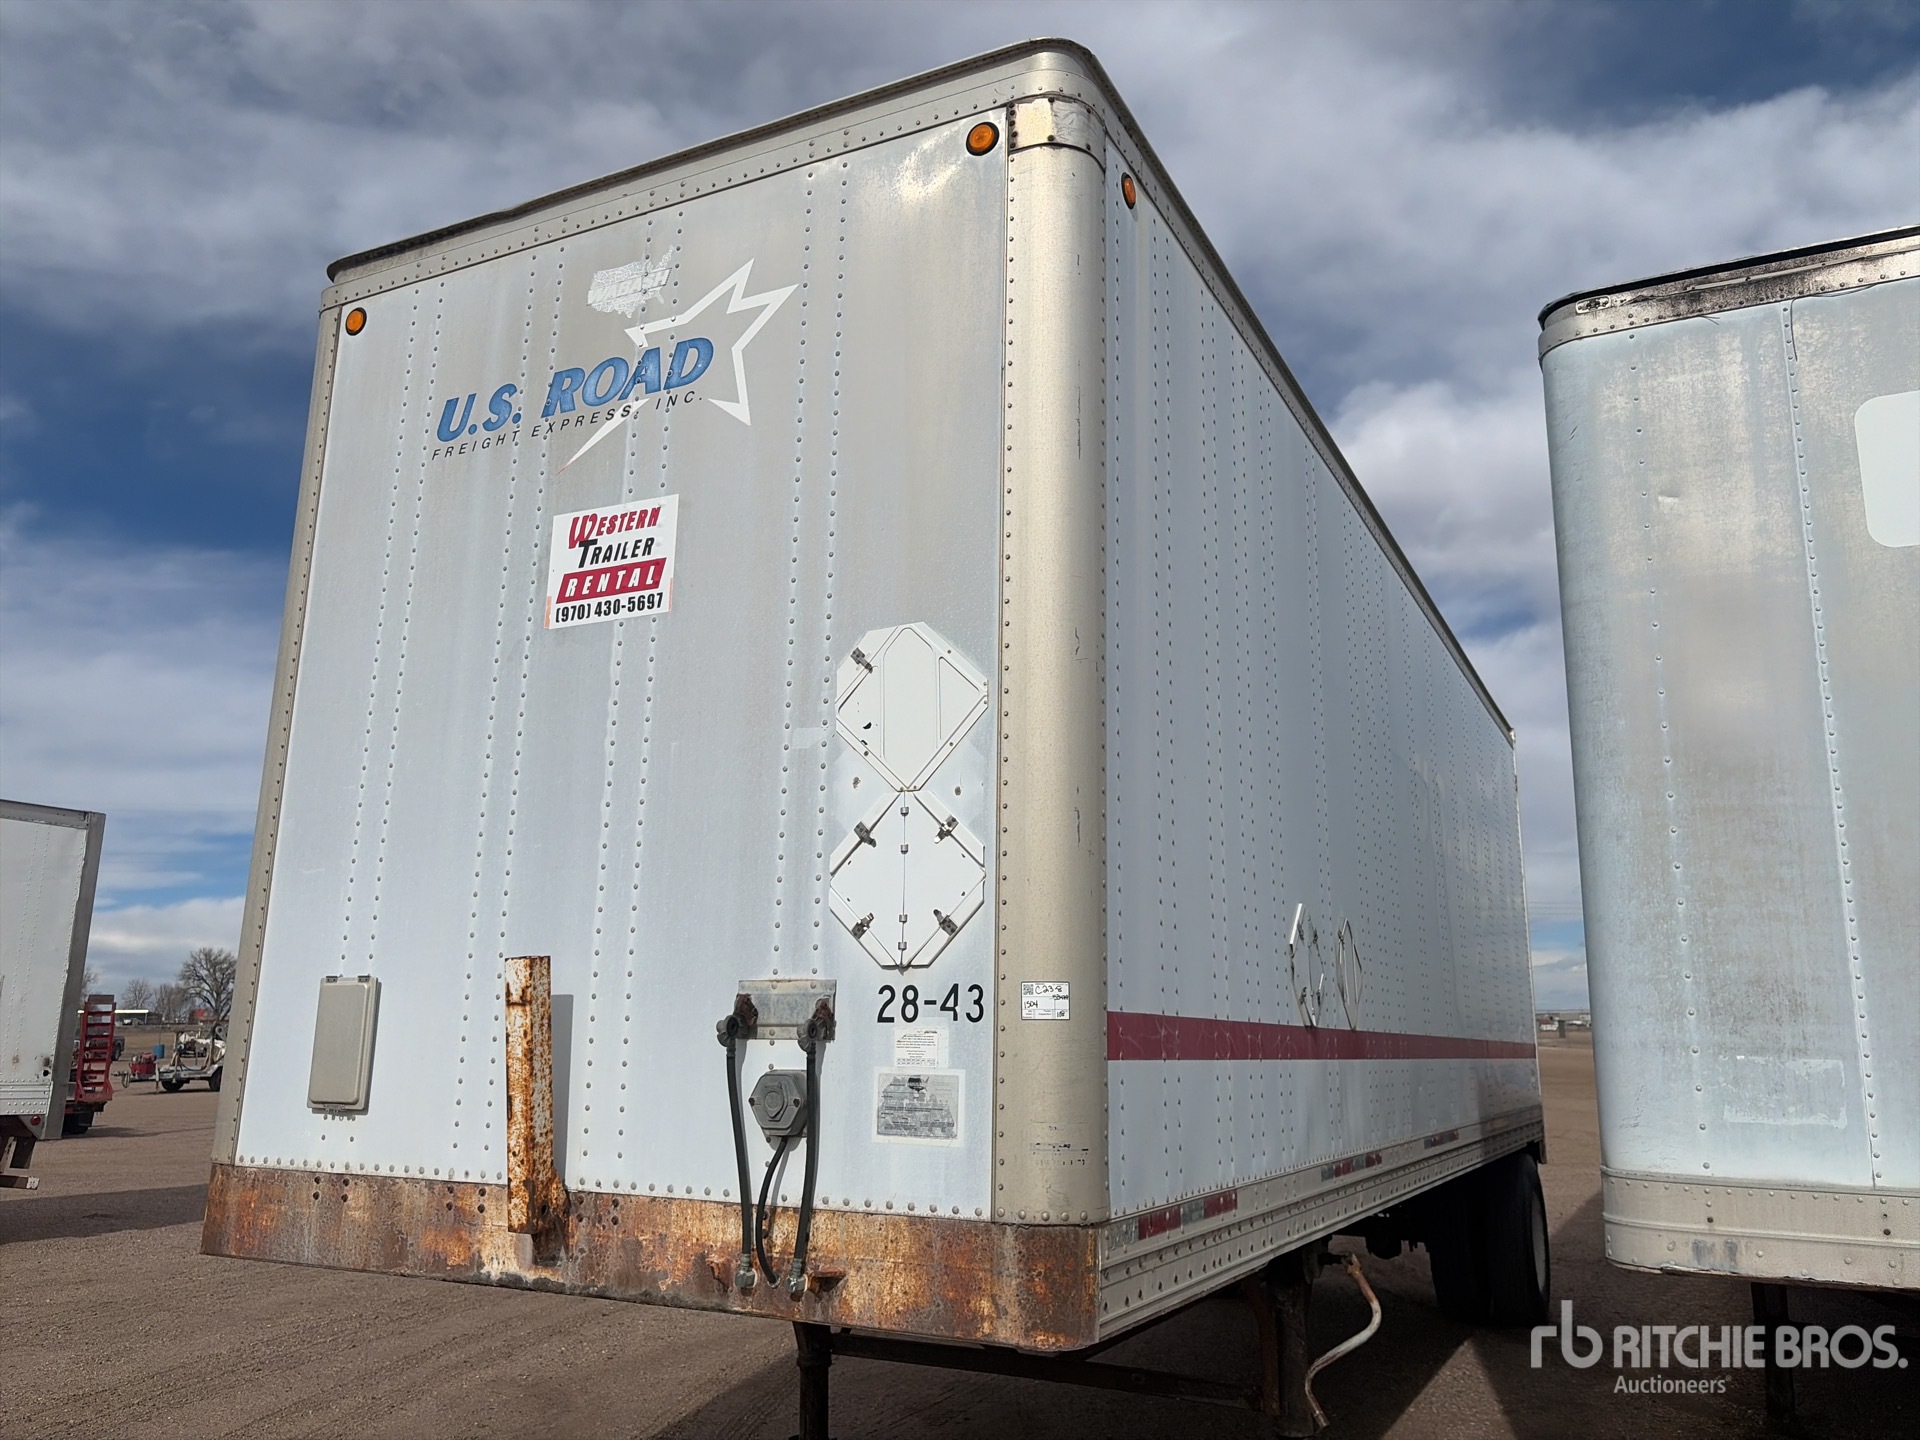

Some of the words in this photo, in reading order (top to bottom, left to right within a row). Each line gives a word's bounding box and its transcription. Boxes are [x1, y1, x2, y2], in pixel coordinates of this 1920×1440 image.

[437, 383, 522, 442] U.S.
[541, 337, 714, 418] ROAD
[432, 430, 520, 461] FREIGHT
[655, 390, 703, 410] INC.
[568, 506, 661, 549] WESTERN
[578, 537, 655, 568] TRAILER
[565, 565, 655, 598] RENTAL
[555, 603, 591, 623] (970)
[594, 592, 663, 617] 430-5697
[877, 983, 984, 1023] 28-43
